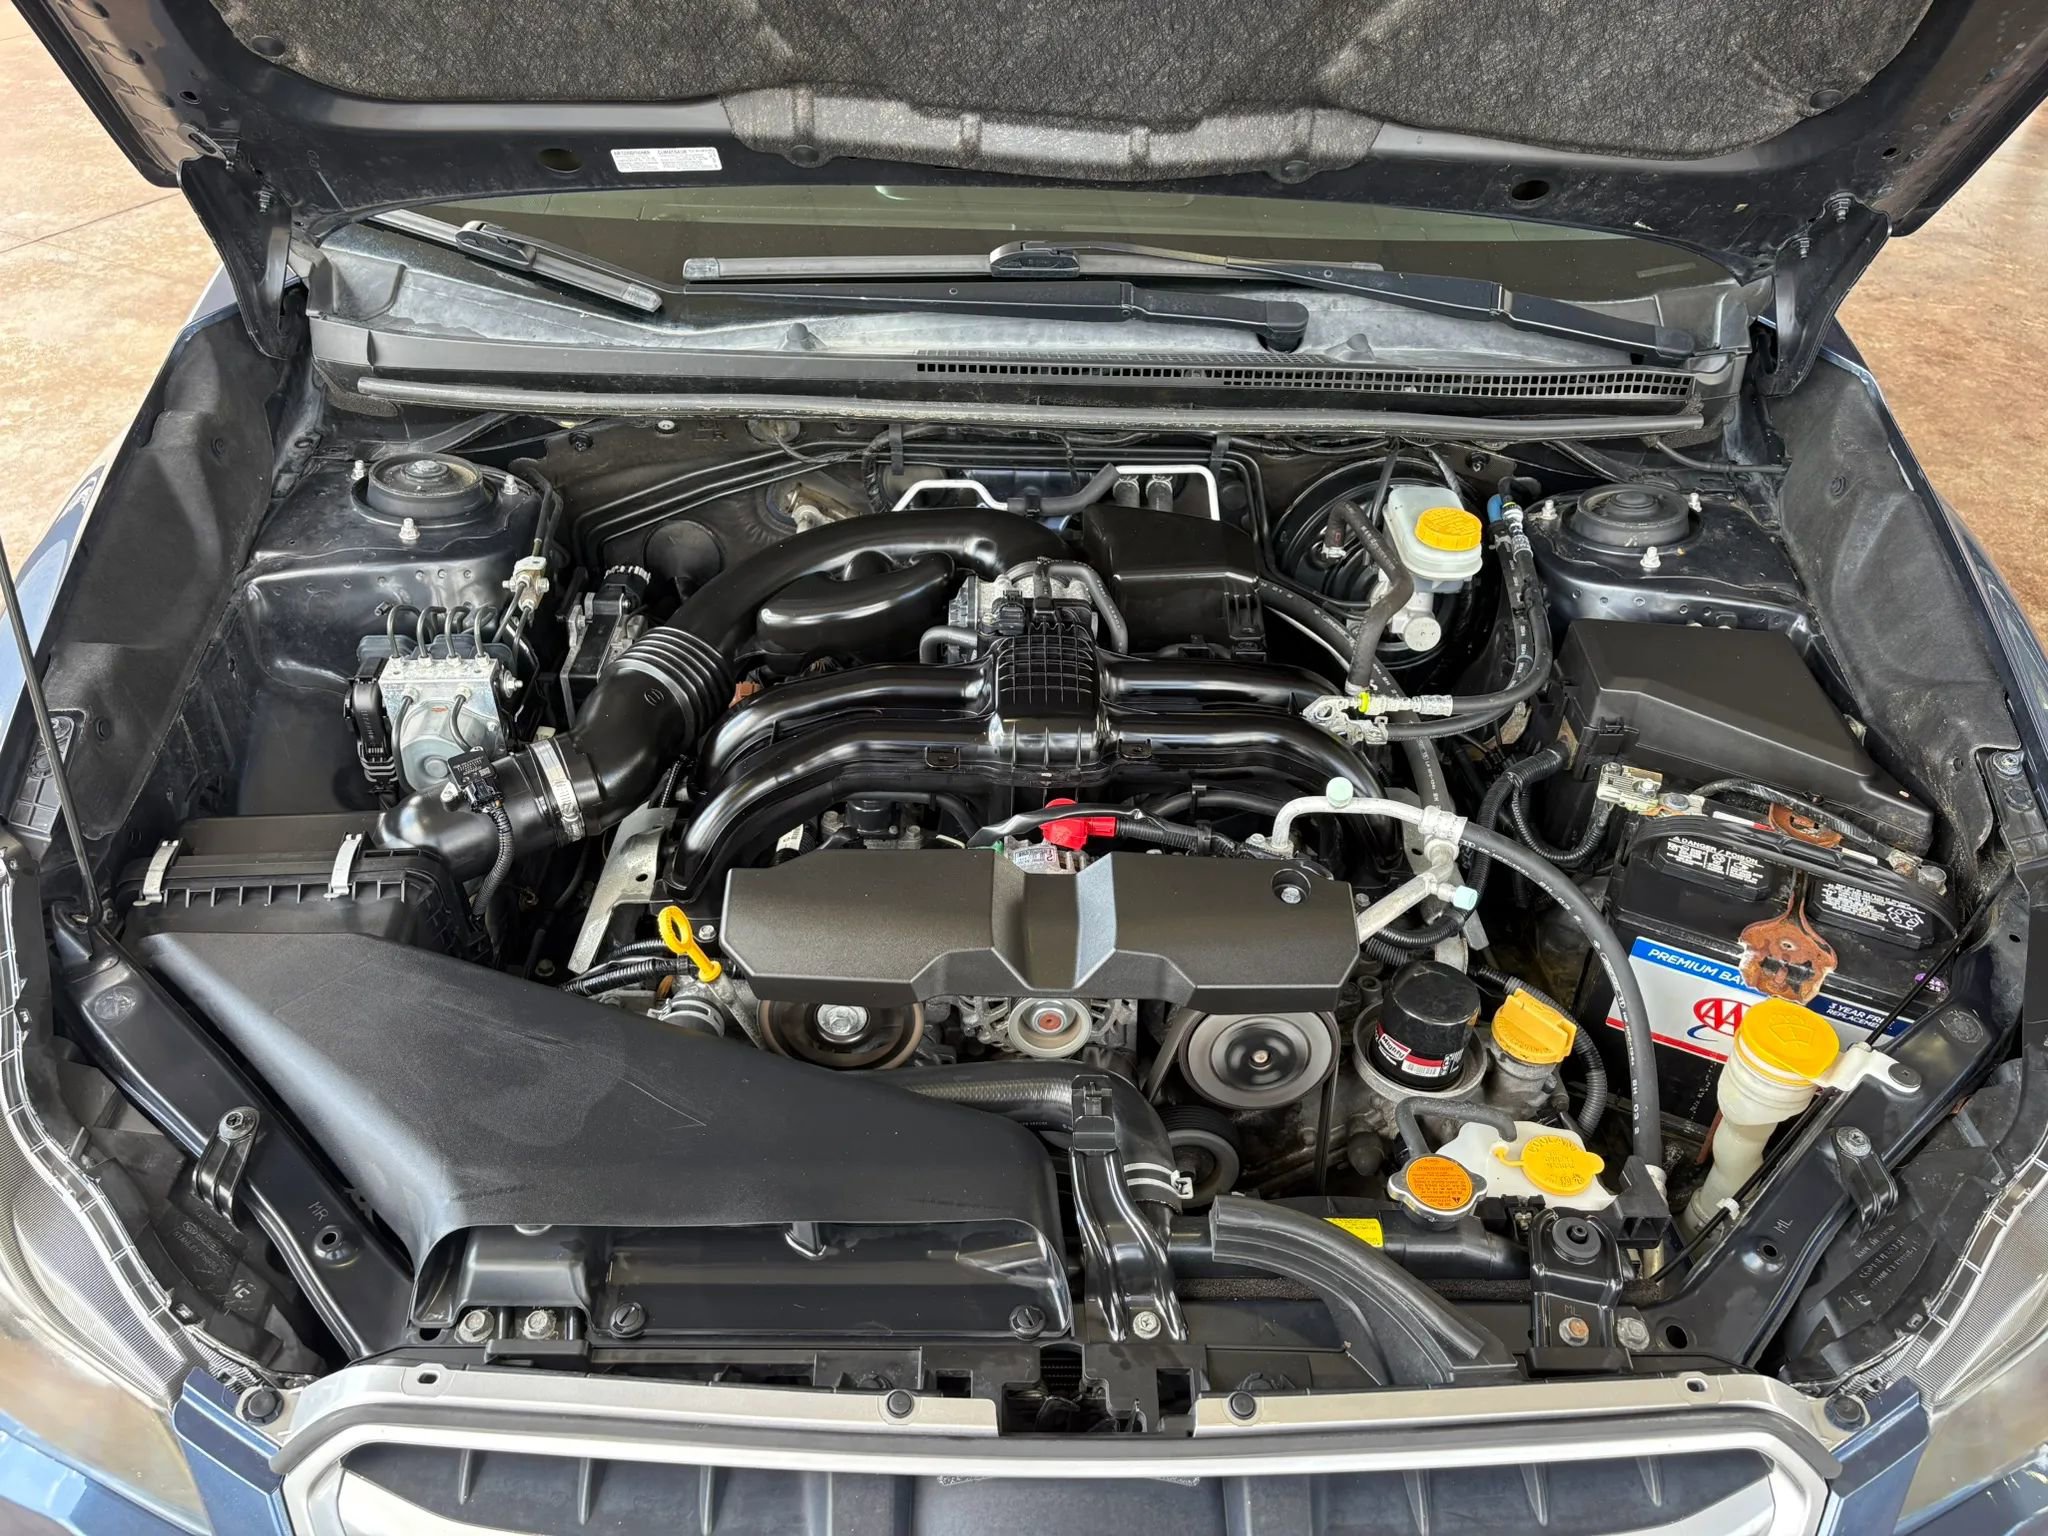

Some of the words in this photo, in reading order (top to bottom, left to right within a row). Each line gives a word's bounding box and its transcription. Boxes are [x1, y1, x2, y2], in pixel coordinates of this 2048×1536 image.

[1681, 838, 1717, 853] DANGER
[1725, 851, 1758, 865] POISON
[1648, 949, 1718, 976] PREMIUM
[1697, 999, 1744, 1036] AA
[1828, 1002, 1836, 1010] 3
[1839, 1003, 1866, 1019] YEAR
[1381, 1035, 1406, 1059] Mighty
